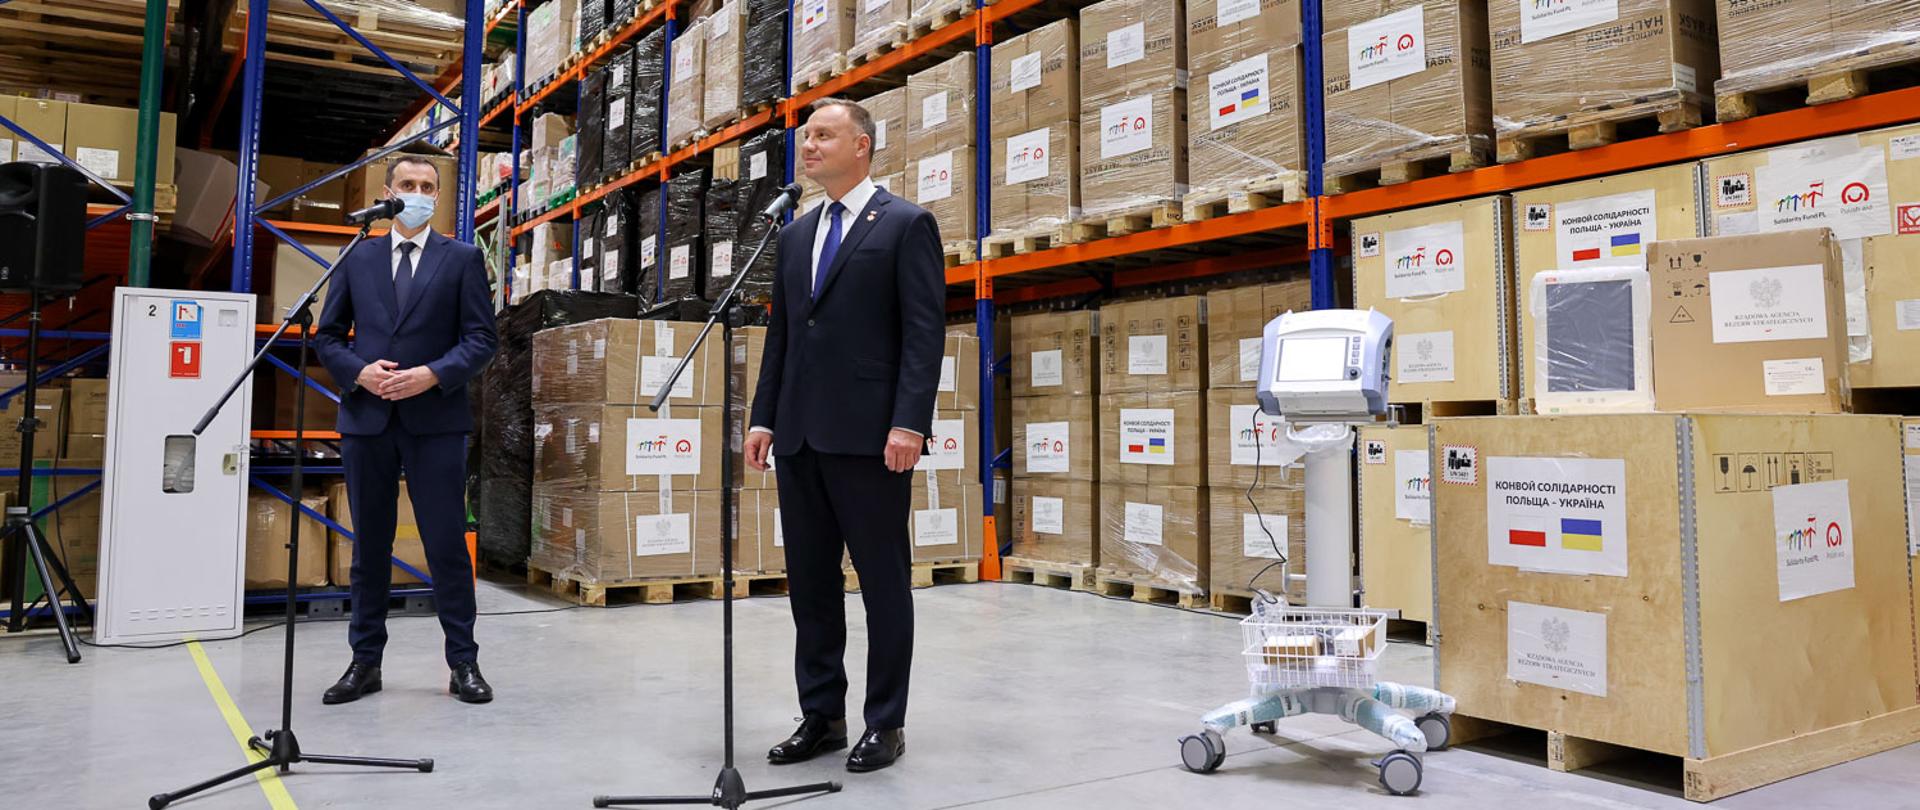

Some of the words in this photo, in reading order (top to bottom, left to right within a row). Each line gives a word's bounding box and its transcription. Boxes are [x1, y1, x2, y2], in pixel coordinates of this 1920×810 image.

[1562, 214, 1593, 226] КОНВОЙ
[1593, 207, 1650, 221] СОЛІДАРНОСТІ
[1773, 215, 1802, 226] Solidarity
[1802, 213, 1817, 221] Fund
[1570, 224, 1602, 234] ПОЛЬЩА
[1608, 219, 1642, 230] УКРАЇНА
[149, 305, 157, 316] 2
[1495, 481, 1536, 491] КОНВОЙ
[1537, 482, 1616, 495] СОЛІДАРНОСТІ
[1506, 495, 1550, 508] ПОЛЬЩА
[1559, 498, 1605, 510] УКРАЇНА
